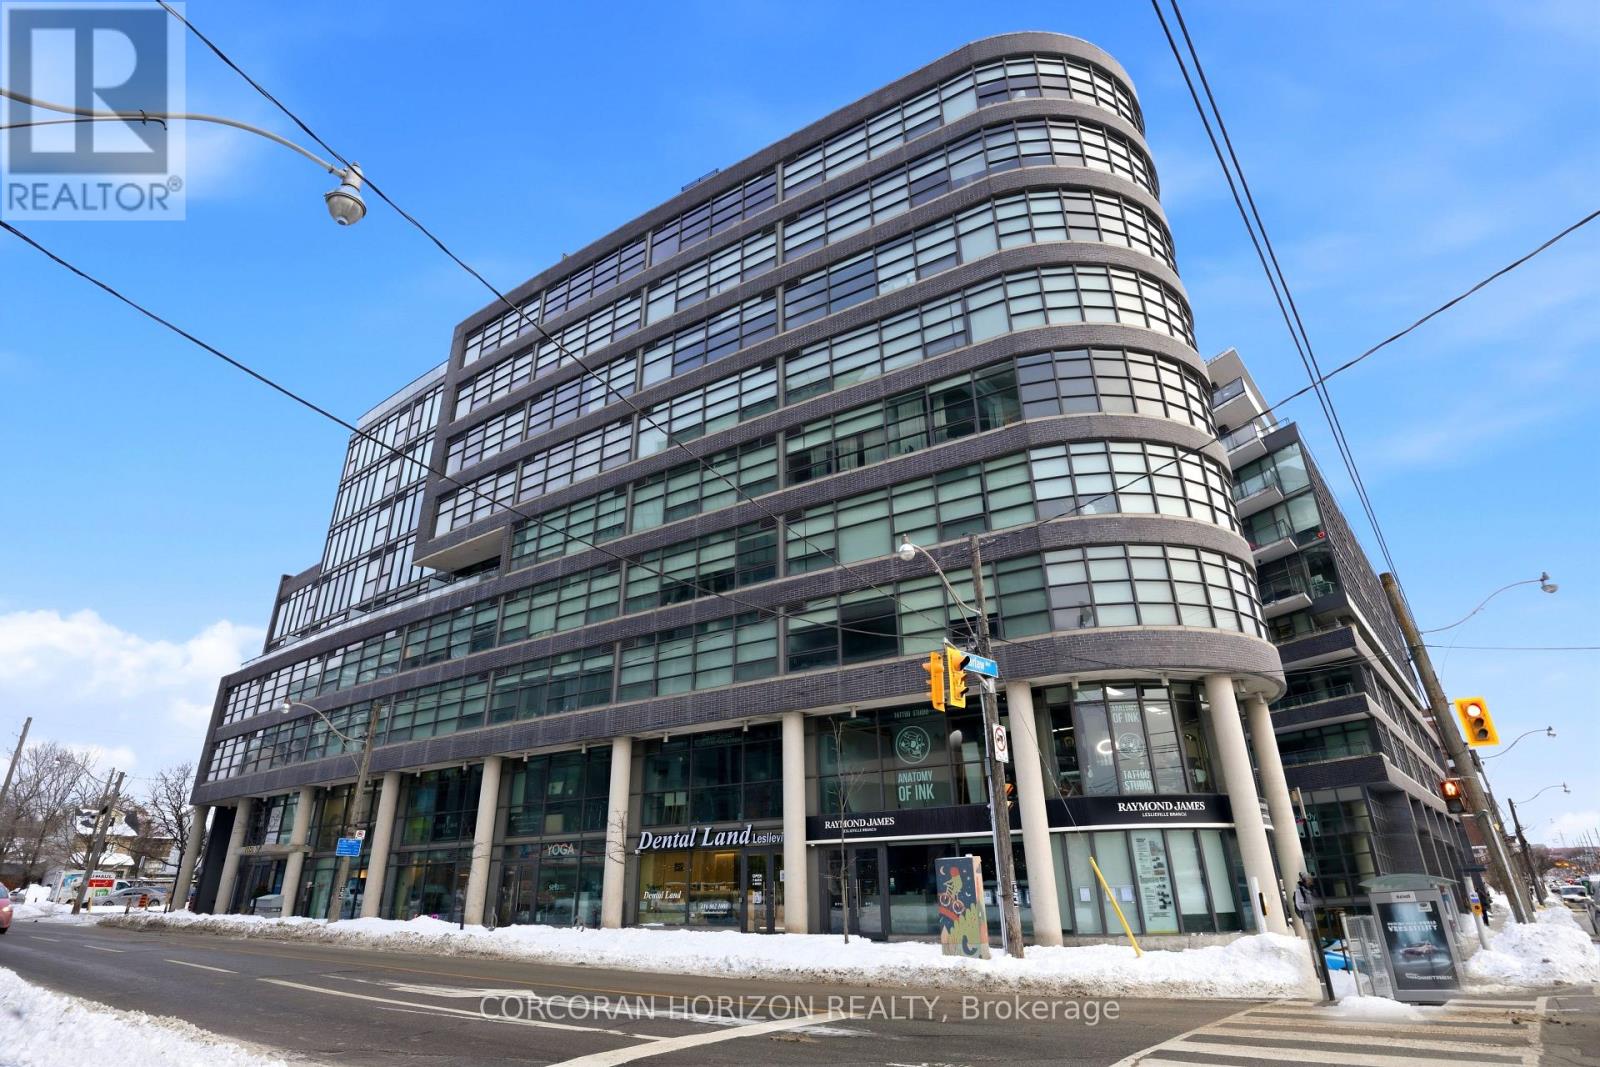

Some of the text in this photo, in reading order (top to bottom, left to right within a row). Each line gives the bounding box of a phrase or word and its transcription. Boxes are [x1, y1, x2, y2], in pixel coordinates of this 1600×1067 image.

[1112, 711, 1140, 724] OF INK
[898, 769, 933, 783] ANATOMY
[1123, 769, 1150, 780] TATTOO
[1124, 780, 1153, 791] STUDIO
[898, 783, 935, 802] OF INK
[1117, 801, 1206, 812] RAYMOND JAMES
[824, 816, 895, 829] RAYMOND JAMES
[637, 827, 697, 850] Dental
[701, 824, 752, 846] Land
[547, 842, 575, 856] YOGA
[643, 890, 682, 900] Dental Land
